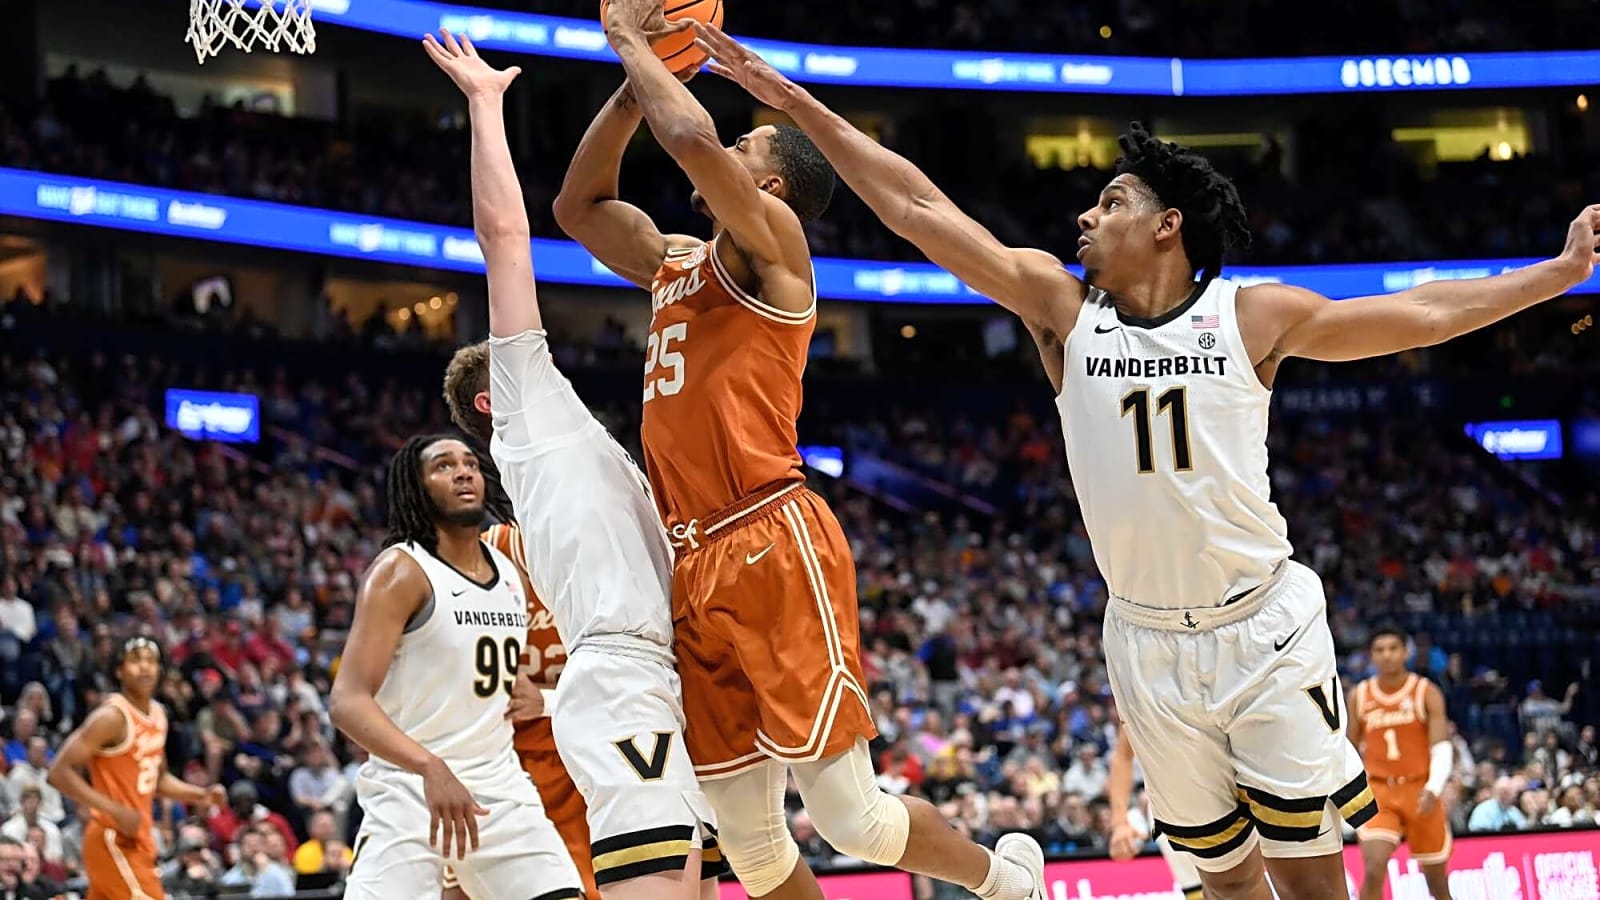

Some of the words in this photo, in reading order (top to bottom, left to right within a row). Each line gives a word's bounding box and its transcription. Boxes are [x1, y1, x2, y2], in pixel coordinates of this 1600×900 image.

[643, 322, 688, 404] 25
[1086, 355, 1228, 378] VANDERBILT
[1199, 333, 1216, 349] SEC
[1120, 385, 1194, 474] 11
[473, 633, 521, 699] 99
[609, 730, 675, 783] V
[1383, 728, 1402, 761] 1
